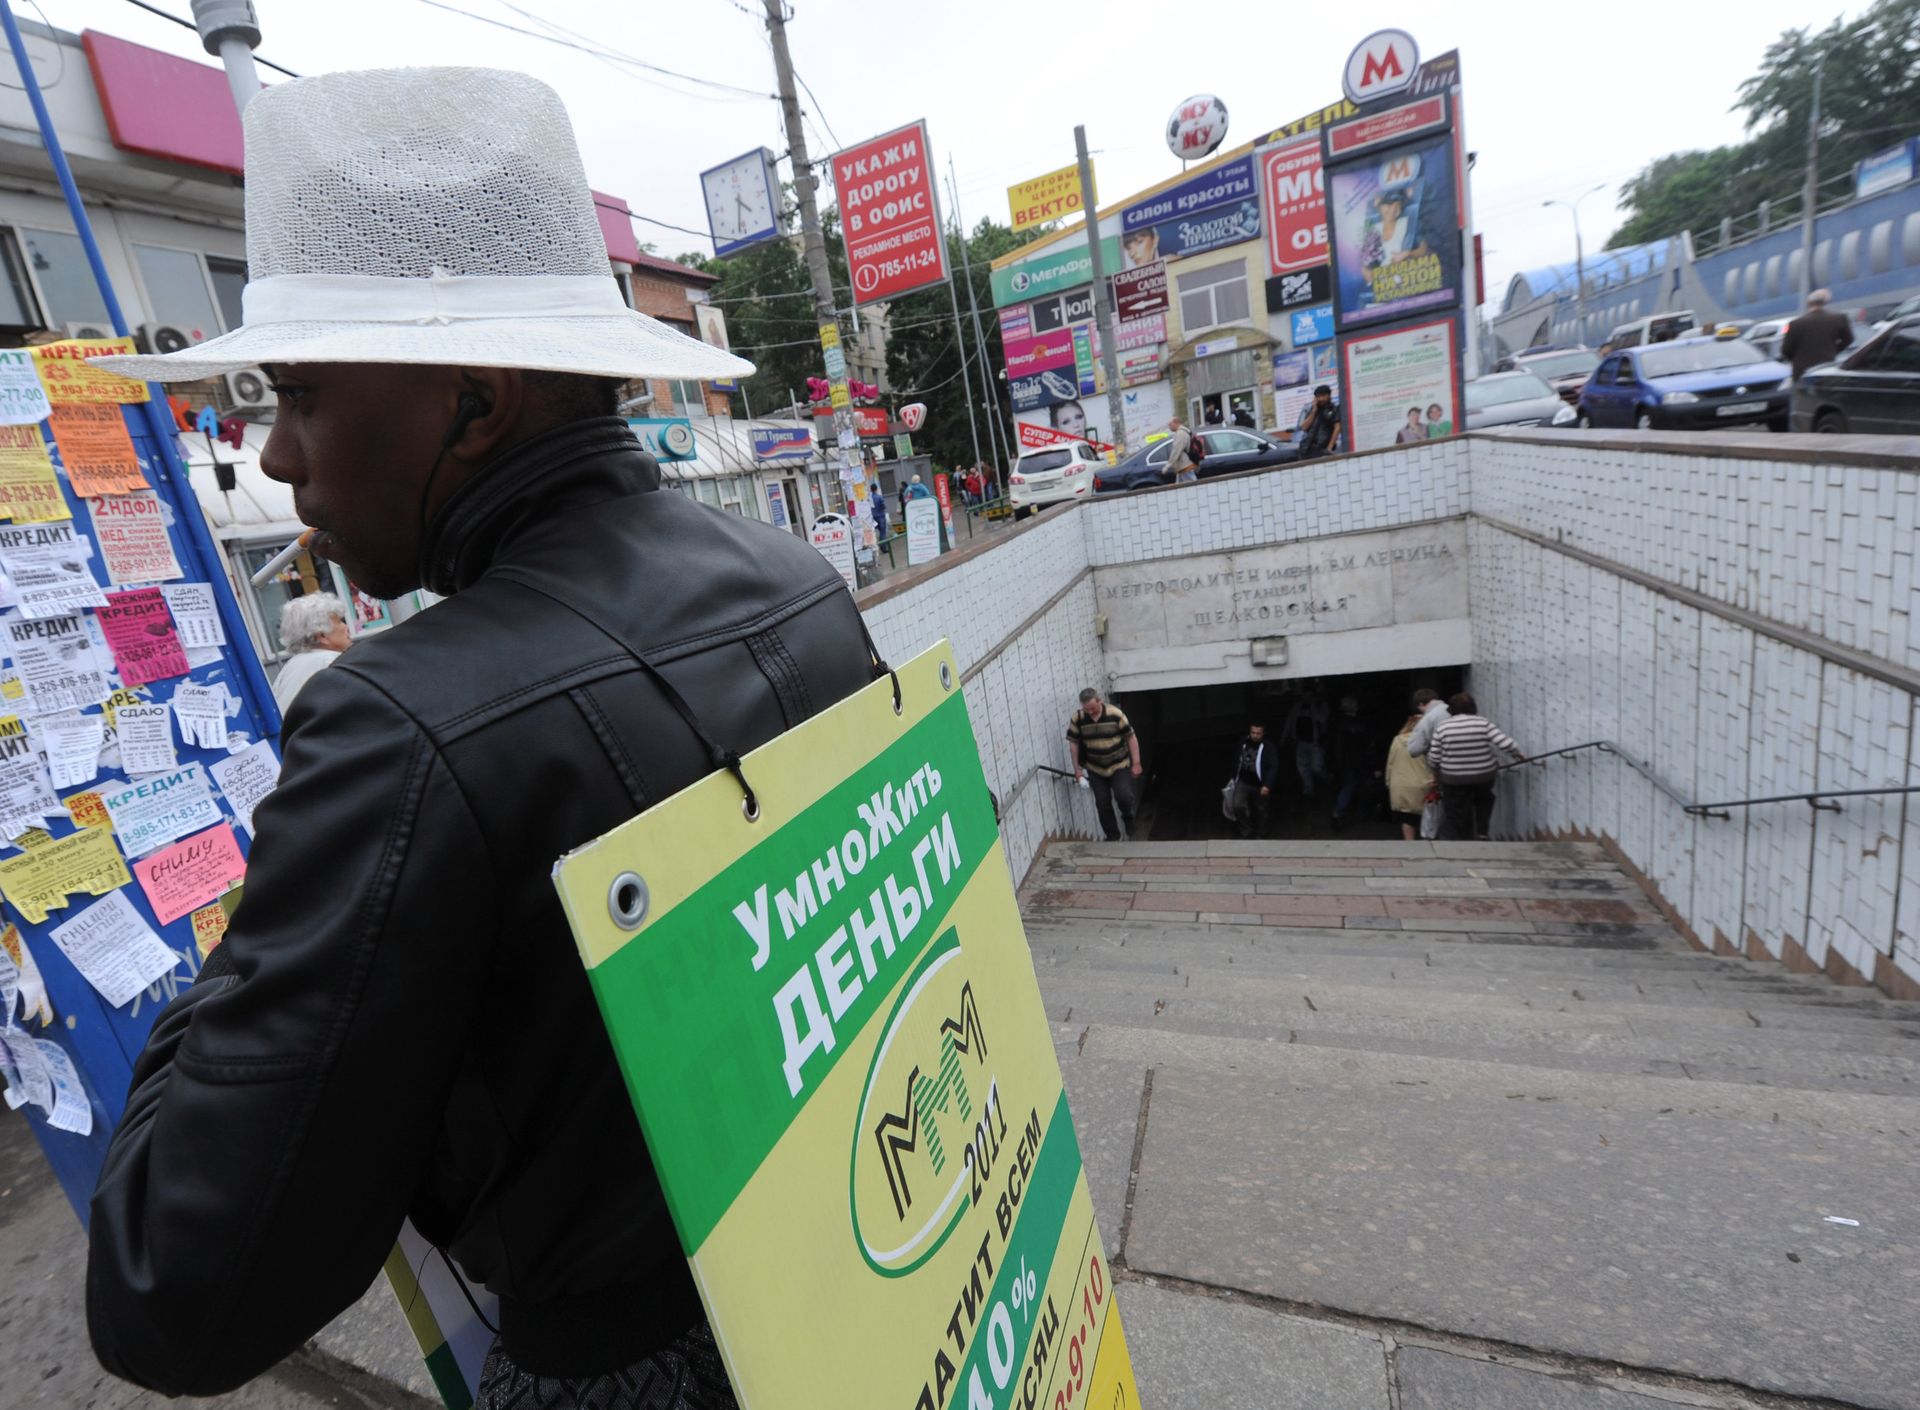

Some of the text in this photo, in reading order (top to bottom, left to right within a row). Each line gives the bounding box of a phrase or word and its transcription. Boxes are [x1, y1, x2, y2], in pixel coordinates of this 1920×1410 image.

[1360, 42, 1404, 88] М
[842, 140, 917, 182] УКАЖИ
[847, 165, 920, 210] ДОРОГУ
[1032, 181, 1071, 201] ЦЕНТР
[1127, 177, 1249, 224] салон красоты
[850, 192, 925, 231] В ОФИС
[1015, 191, 1081, 225] ВЕКТО
[853, 225, 931, 260] РЕКЛАМНОЕ МЕСТО
[878, 247, 936, 279] 785-11-24
[1137, 276, 1166, 292] САЛОН
[1023, 427, 1053, 442] СУПЕР
[0, 527, 72, 547] КРЕДИТ
[1105, 567, 1260, 600] МЕТРОПОЛИТЕН
[1364, 544, 1453, 568] ЛЕНИНА
[10, 616, 79, 641] КРЕДИТ
[101, 602, 164, 619] КРЕДИТ
[120, 707, 164, 718] СДАЮ
[107, 767, 196, 810] КРЕДИТ
[196, 915, 229, 932] КРЕ
[773, 812, 962, 1098] ДЕНЬГИ
[876, 980, 989, 1222] МММ
[965, 1082, 1007, 1208] 2011
[995, 1107, 1041, 1243] ВСЕМ
[1015, 1294, 1060, 1410] СЯЦ
